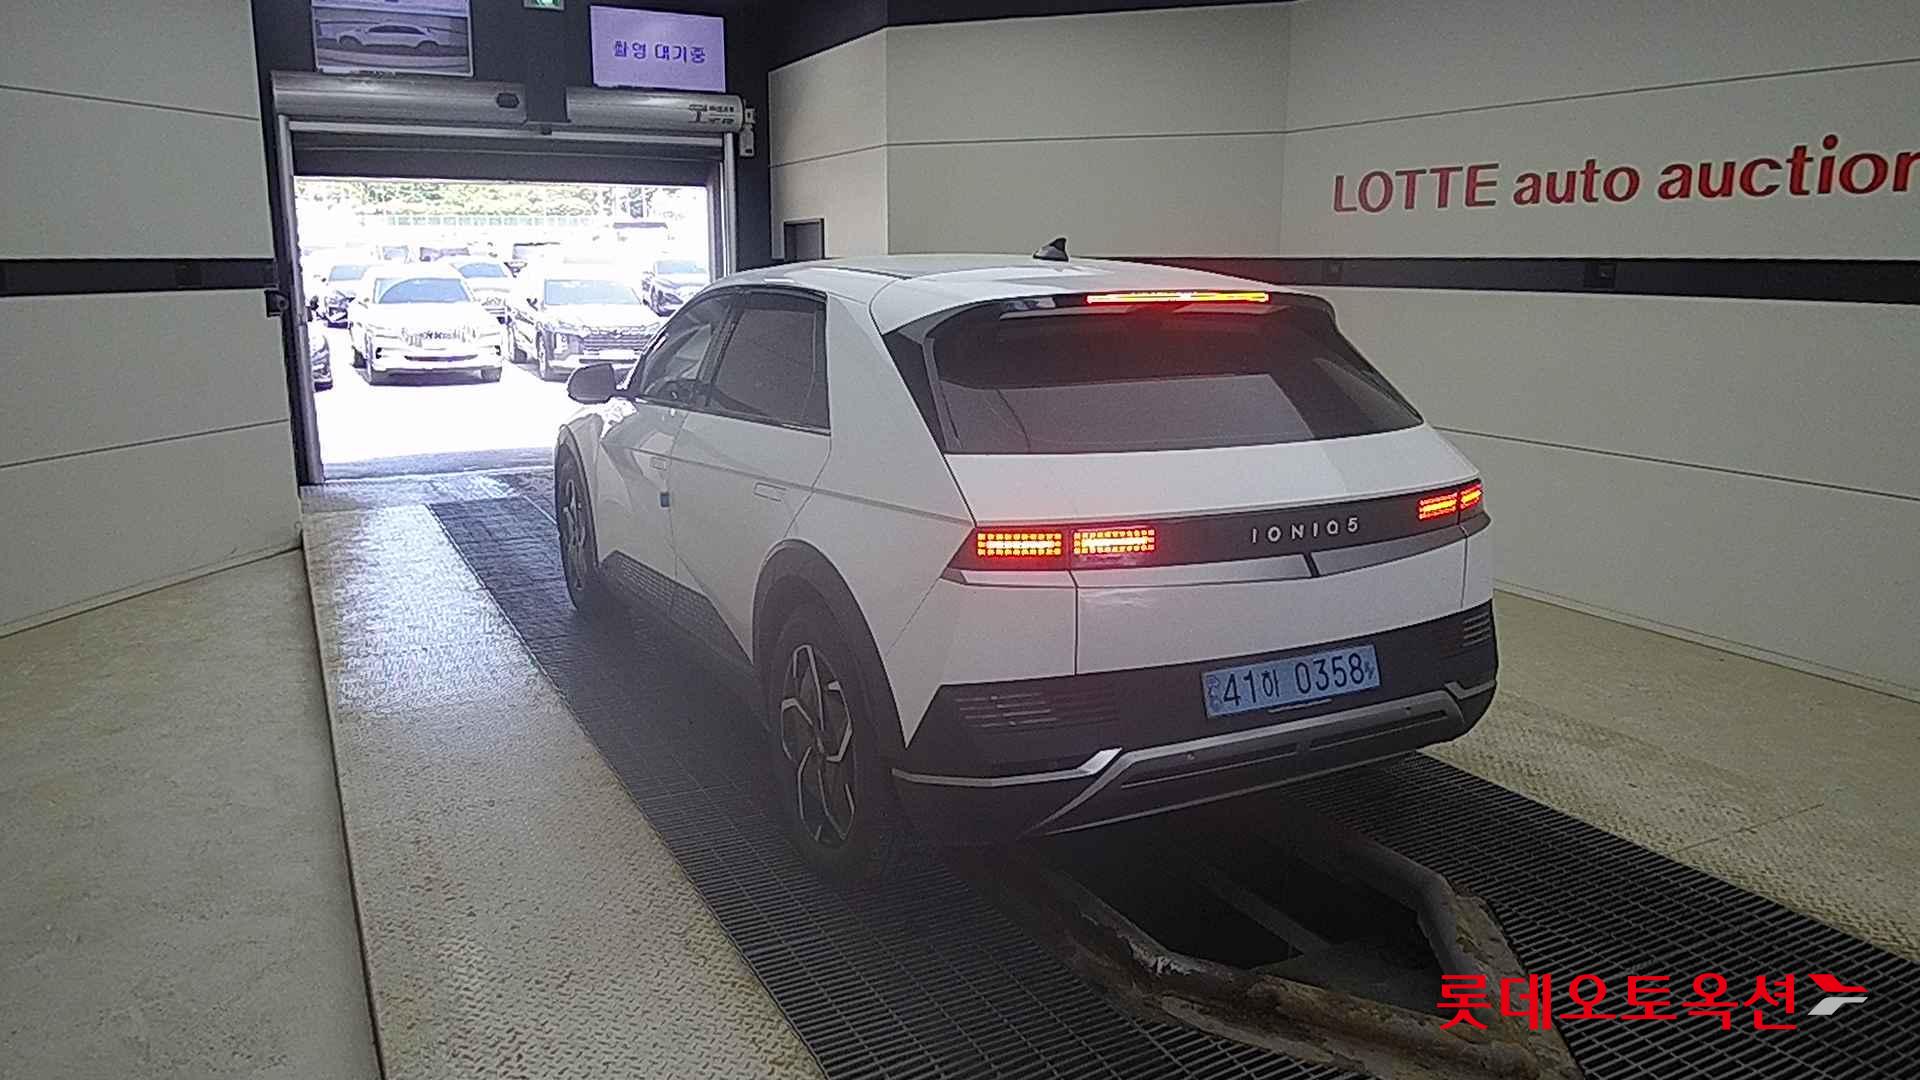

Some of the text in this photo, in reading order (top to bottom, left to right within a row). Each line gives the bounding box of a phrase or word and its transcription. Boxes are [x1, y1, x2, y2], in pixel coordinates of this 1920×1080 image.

[654, 43, 706, 64] 대기중
[1333, 162, 1500, 214] LOTTE
[1512, 157, 1641, 206] auto
[1295, 652, 1365, 694] 0358
